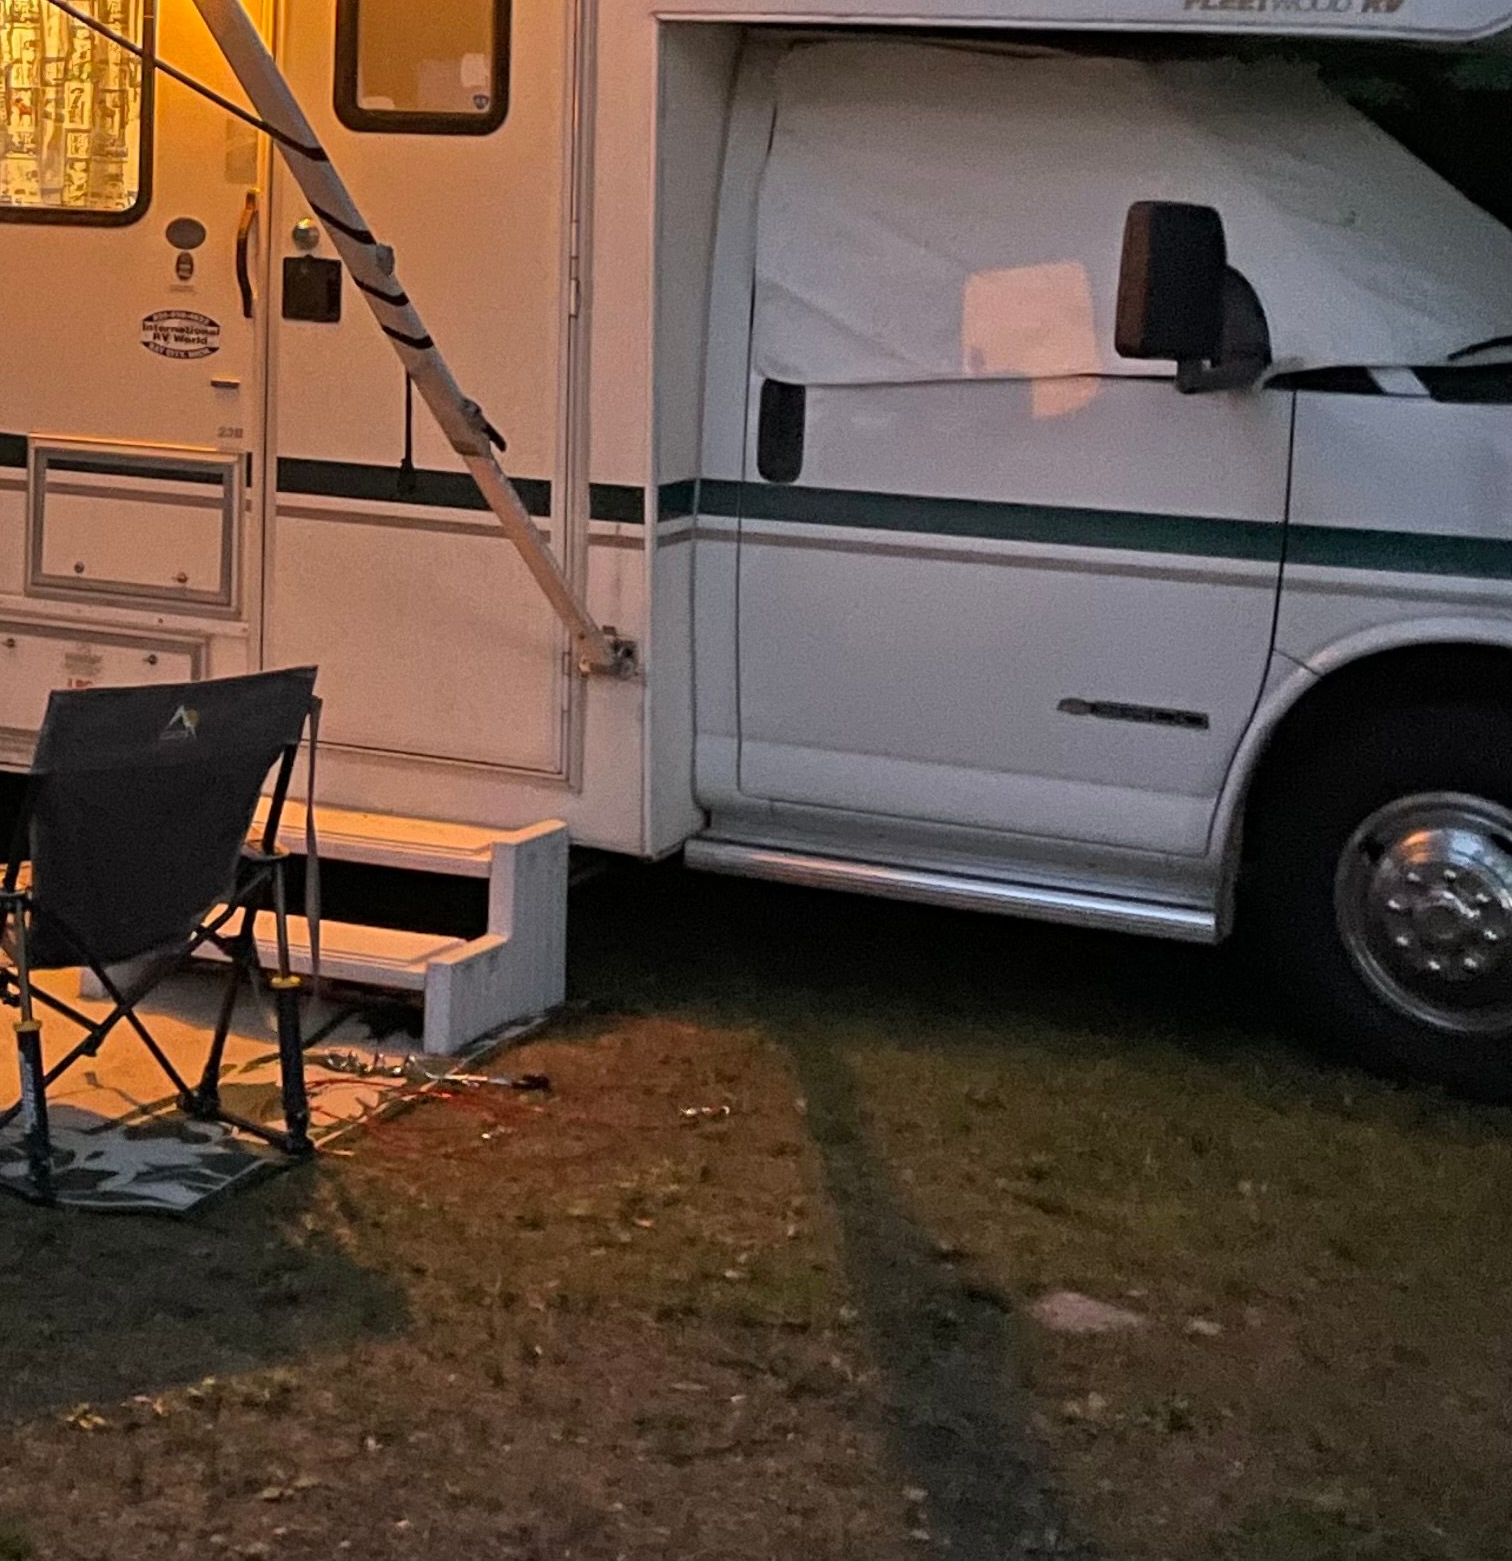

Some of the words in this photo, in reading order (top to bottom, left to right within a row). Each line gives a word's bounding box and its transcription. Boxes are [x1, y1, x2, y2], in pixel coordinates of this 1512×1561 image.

[142, 321, 220, 336] International
[152, 332, 170, 343] RV
[174, 333, 208, 345] World
